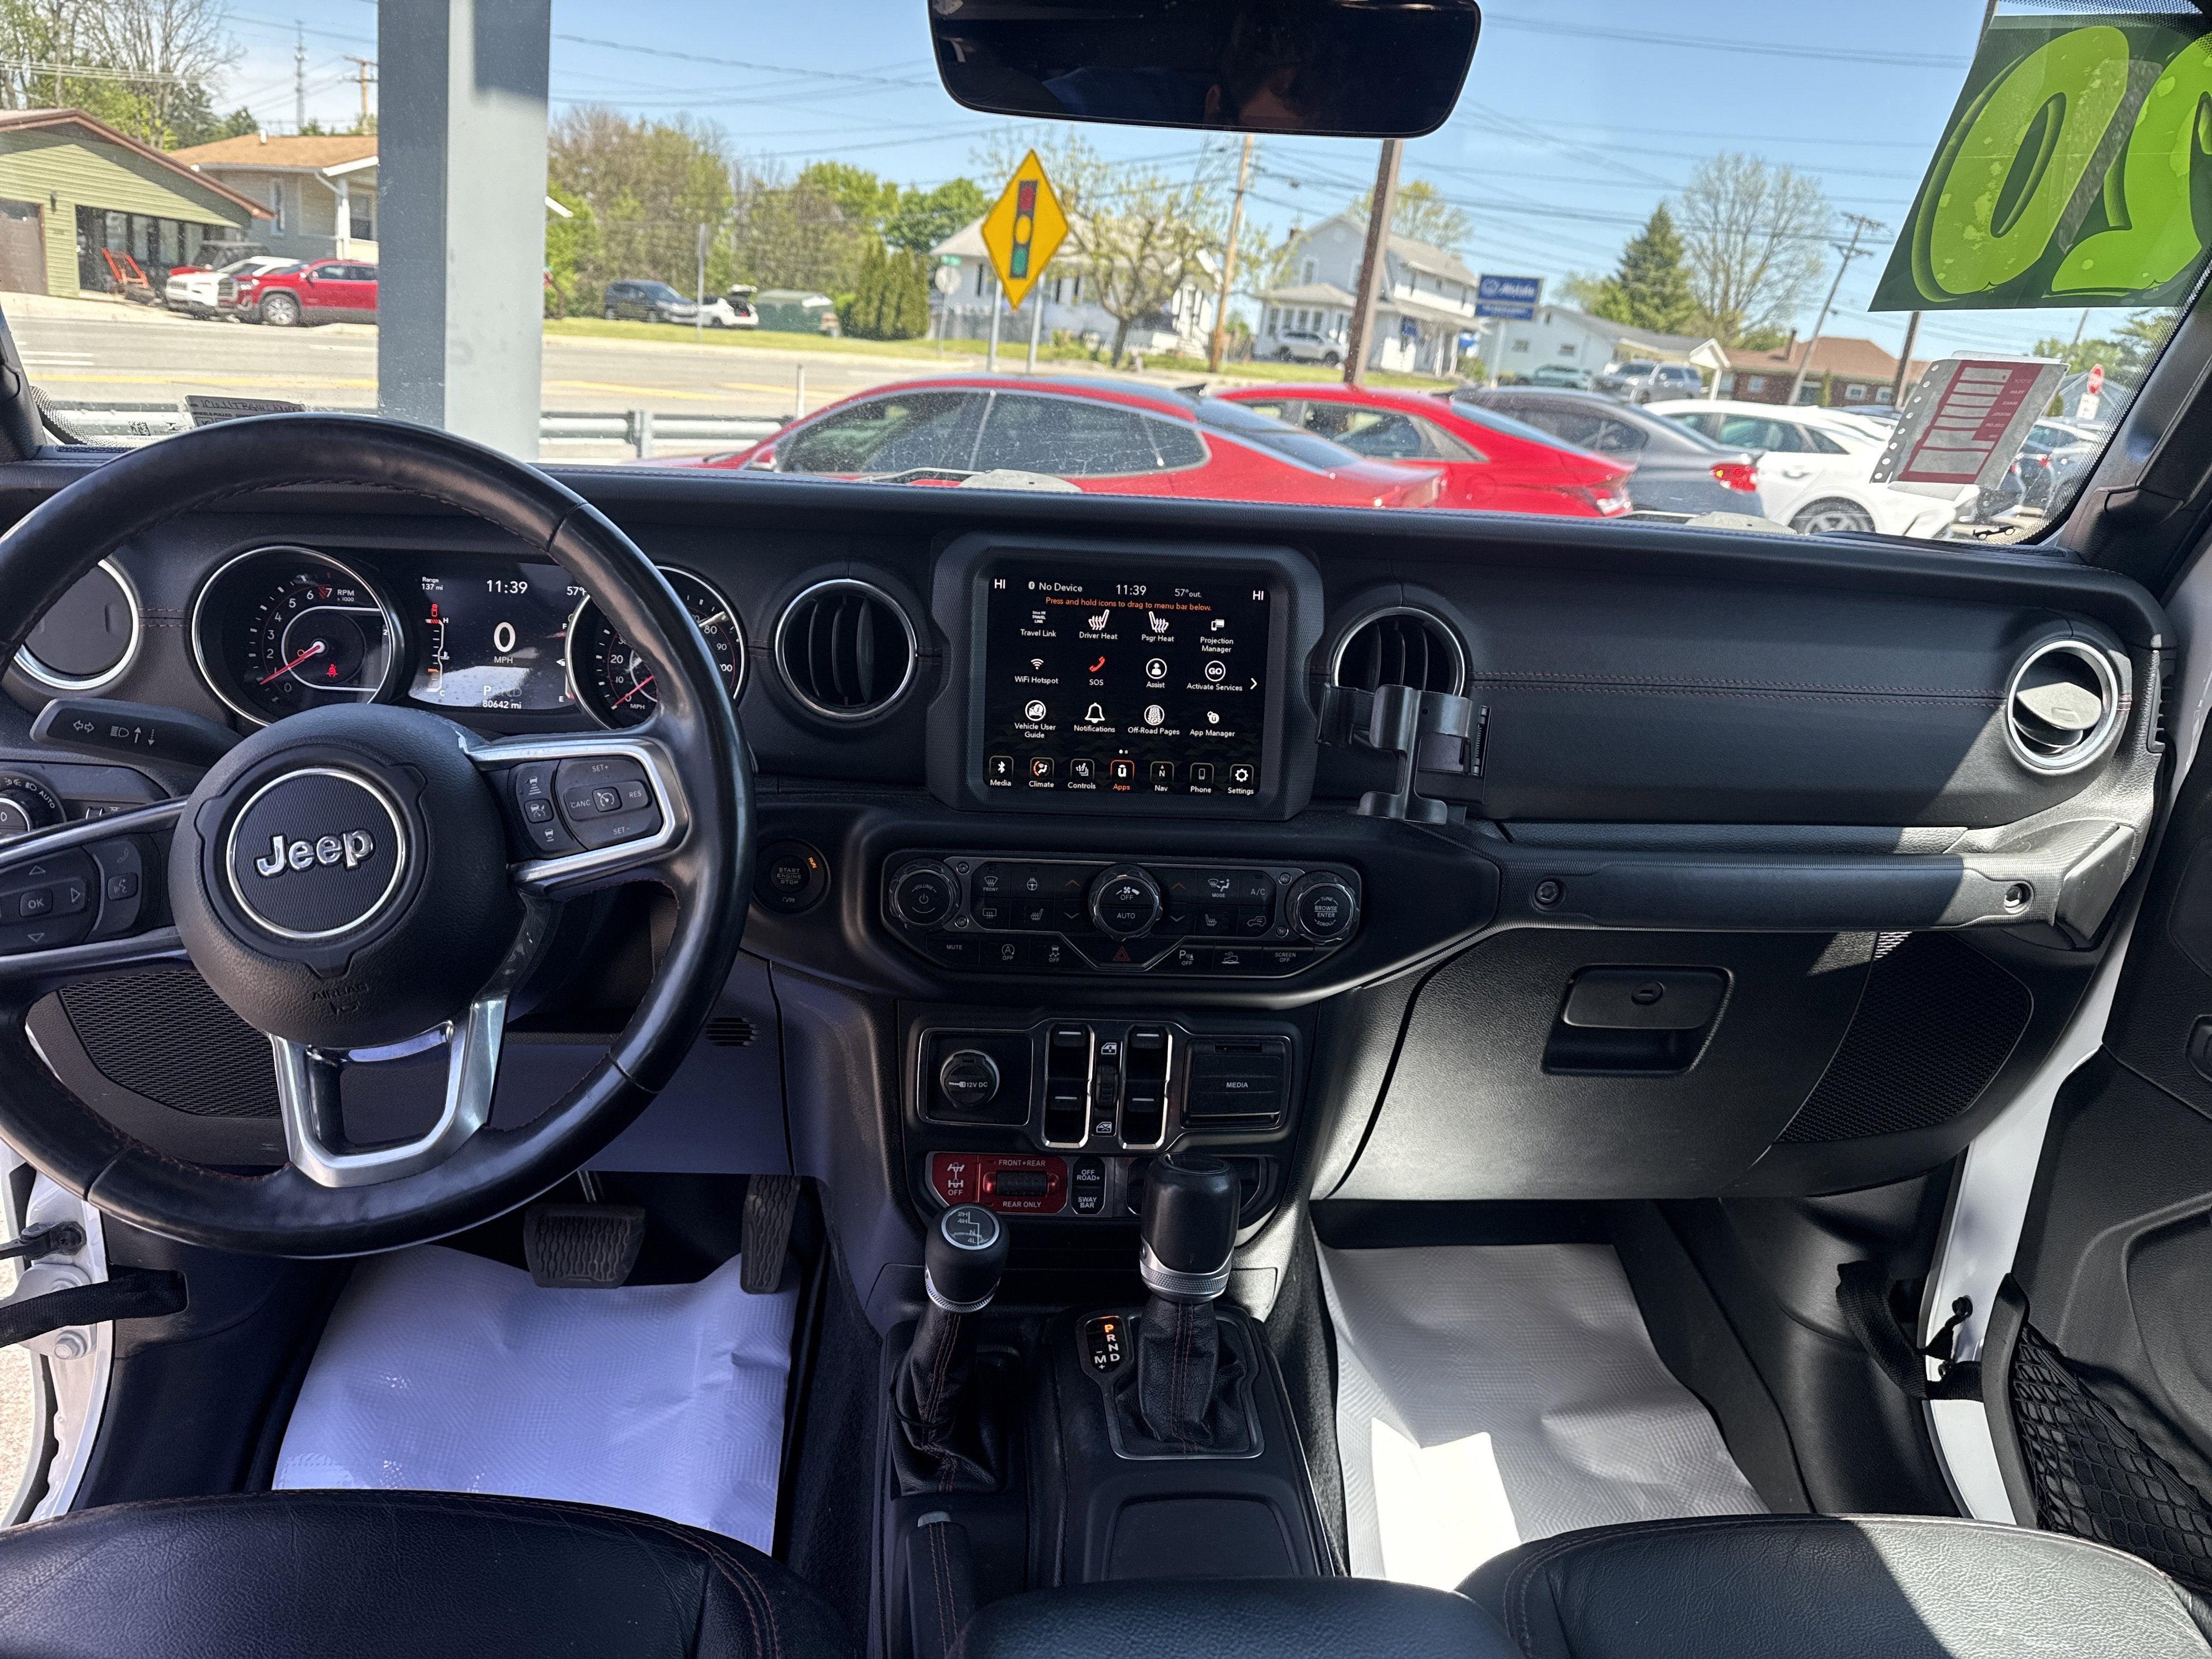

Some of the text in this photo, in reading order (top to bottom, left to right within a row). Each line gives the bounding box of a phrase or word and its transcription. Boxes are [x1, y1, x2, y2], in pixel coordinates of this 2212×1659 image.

[487, 580, 528, 594] 11:39
[994, 579, 1006, 589] HI
[1039, 582, 1083, 592] No Device
[307, 590, 314, 600] 6
[325, 588, 332, 597] 7
[1116, 584, 1147, 596] 11:39
[1252, 590, 1264, 601] HI
[289, 599, 296, 608] 5
[1046, 596, 1064, 605] Press
[1127, 601, 1143, 609] drag
[274, 612, 282, 622] 4
[704, 625, 718, 634] 80
[267, 630, 275, 640] 3
[494, 622, 516, 652] 0
[1200, 636, 1234, 645] Projection
[267, 648, 274, 658] 2
[1201, 645, 1232, 653] Manager
[610, 654, 624, 664] 20
[719, 664, 733, 672] 00
[1031, 676, 1059, 685] Hotspot
[284, 682, 292, 692] 0
[482, 699, 509, 709] 80642
[1074, 724, 1116, 733] Notifications
[1127, 726, 1158, 735] Off-Road
[1189, 729, 1235, 738] App Manager
[1112, 783, 1131, 792] Apps
[1227, 787, 1254, 795] Settings
[629, 790, 642, 798] RES
[38, 790, 55, 809] AUTO
[570, 799, 591, 809] CANC
[255, 828, 375, 877] Jeep
[28, 898, 44, 909] OK
[1104, 1324, 1114, 1333] P
[1106, 1334, 1116, 1342] R
[1108, 1343, 1119, 1352] N
[1094, 1353, 1120, 1364] M D
